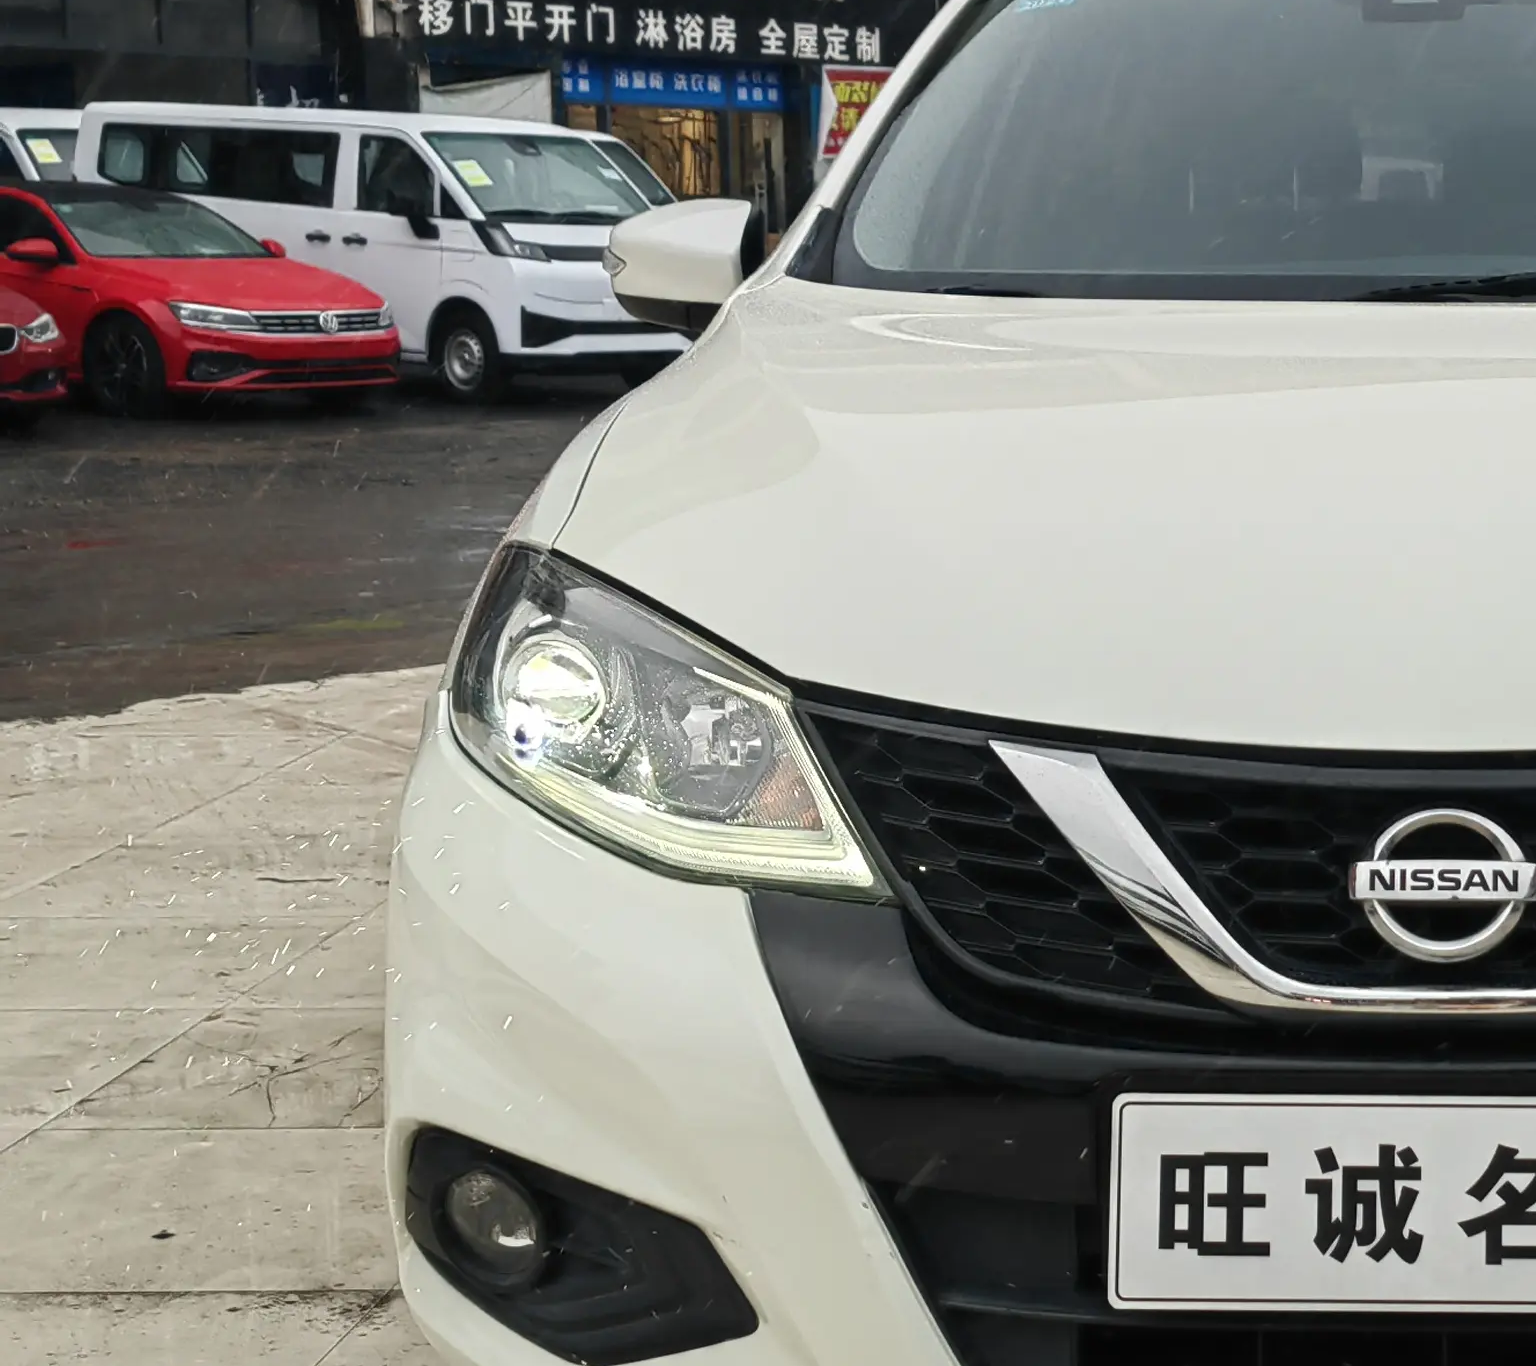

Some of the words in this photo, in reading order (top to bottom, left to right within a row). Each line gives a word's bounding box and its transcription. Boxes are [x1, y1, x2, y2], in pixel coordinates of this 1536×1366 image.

[636, 9, 737, 55] 淋浴房
[758, 17, 881, 63] 全屋定制
[1368, 867, 1520, 892] NISSAN
